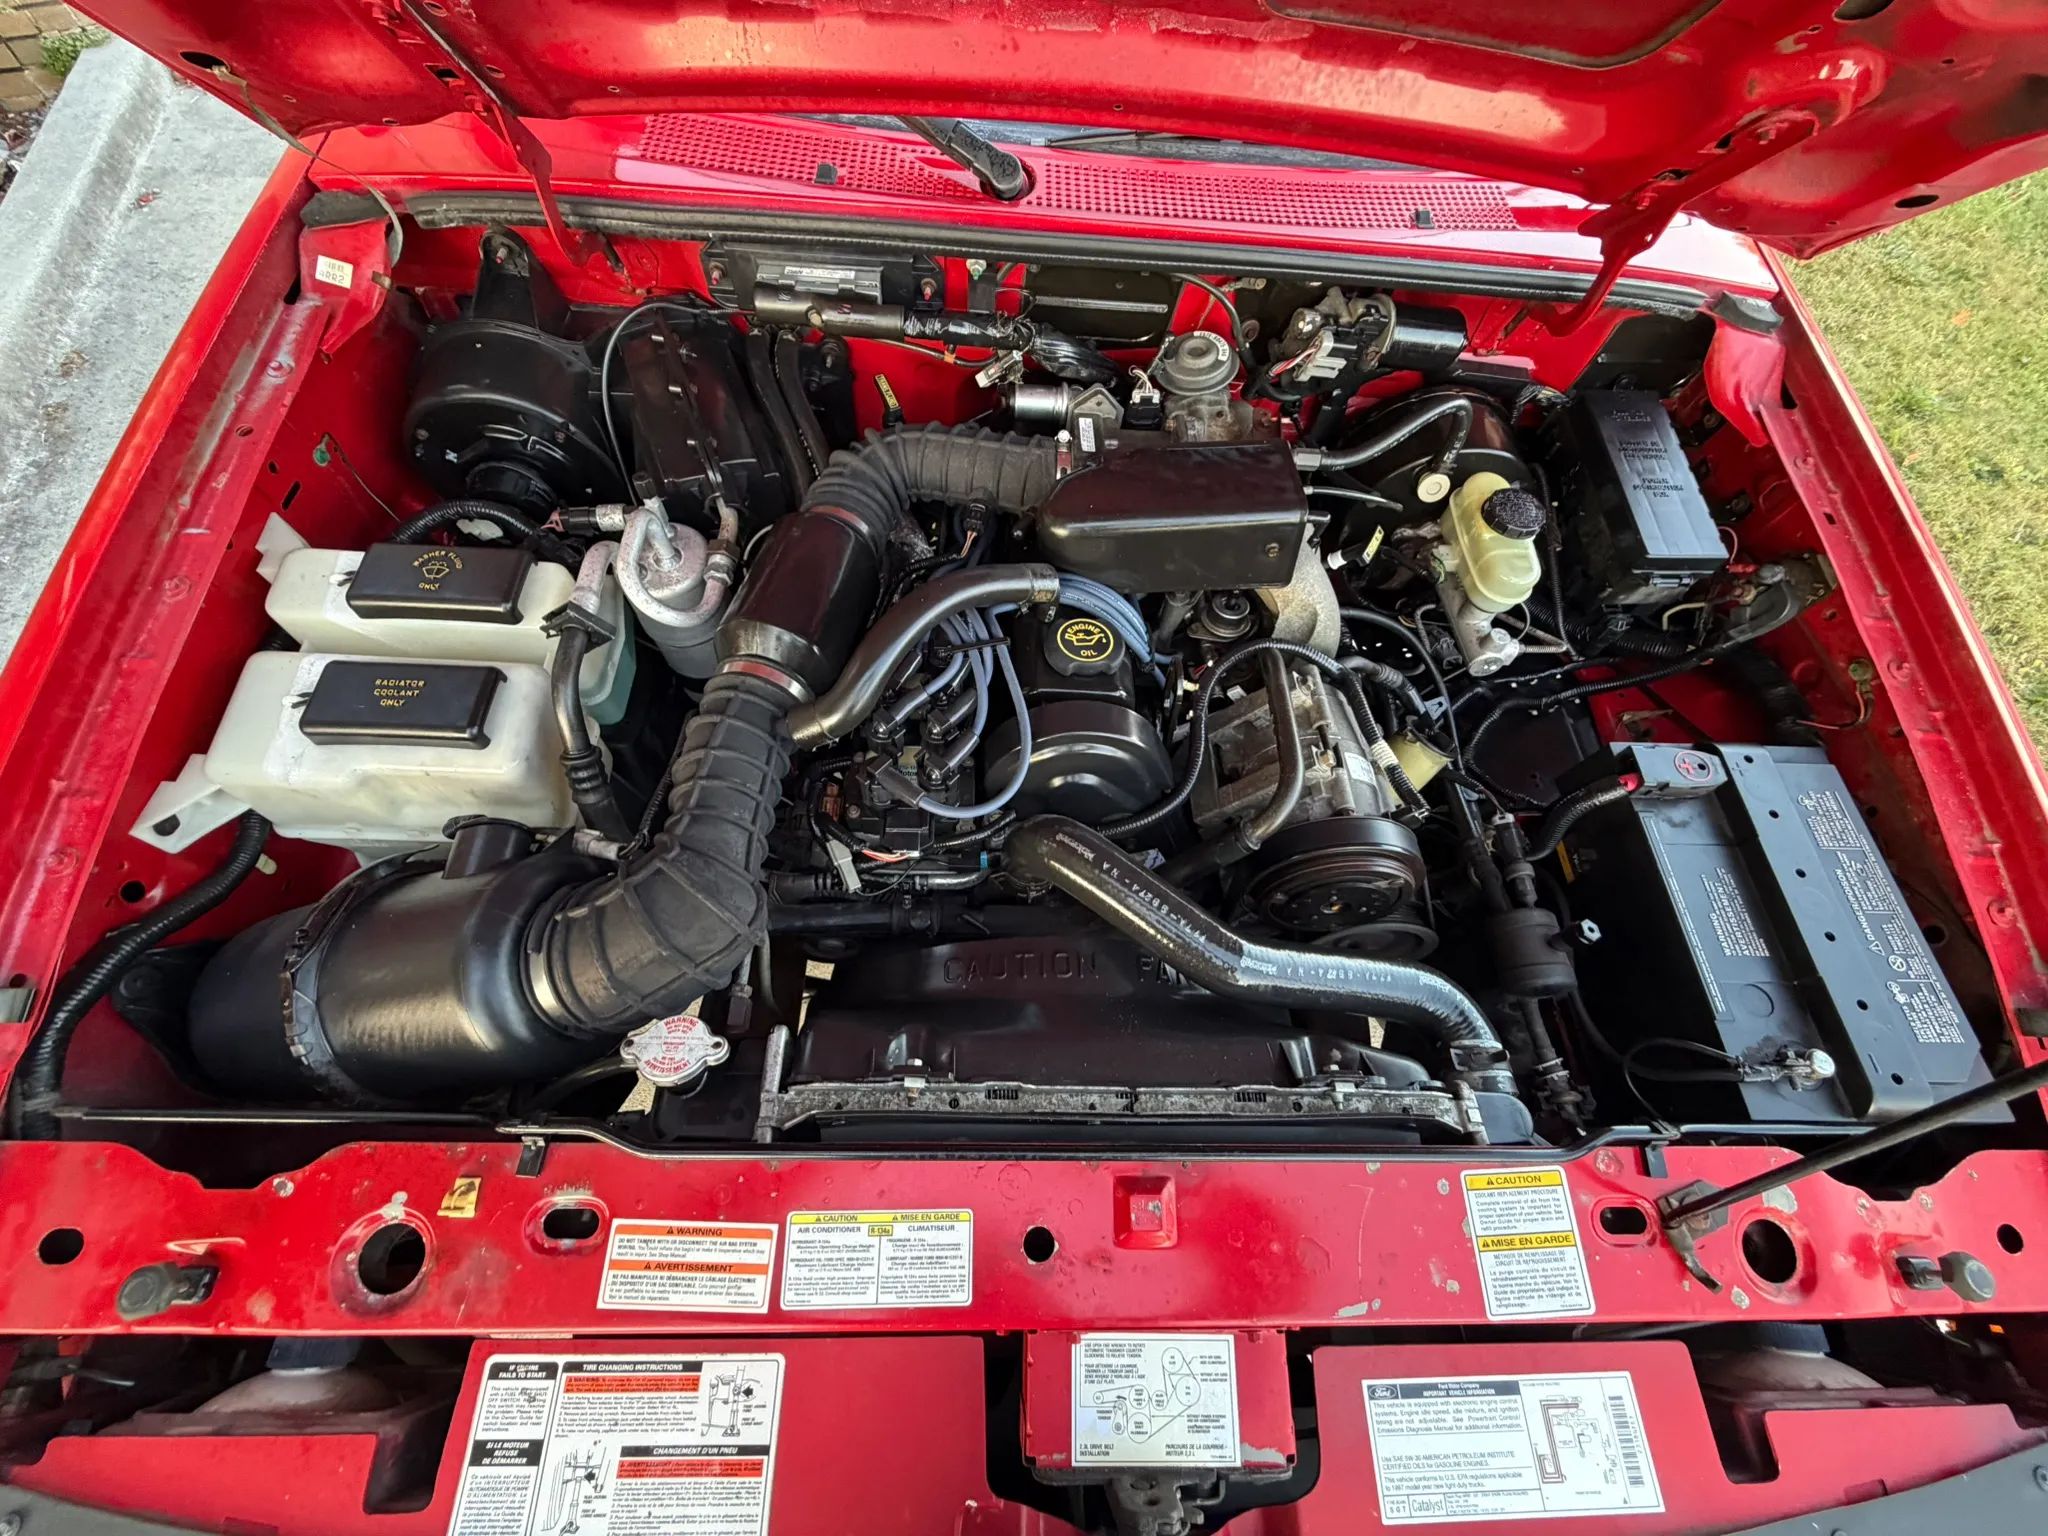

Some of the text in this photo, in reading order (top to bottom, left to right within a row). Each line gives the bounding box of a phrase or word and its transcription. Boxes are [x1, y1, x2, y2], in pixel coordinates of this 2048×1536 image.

[412, 550, 464, 570] WASHER FLUID
[418, 582, 440, 591] ONLY
[1067, 623, 1101, 634] ENGINE
[1080, 649, 1098, 657] OIL
[375, 678, 425, 688] RADIATOR
[374, 688, 419, 697] COOLANT
[380, 698, 406, 708] ONLY
[1833, 868, 1875, 940] DANGER/POISON
[1714, 880, 1750, 957] AVERTISSEMENT
[1711, 912, 1733, 956] WARNING
[943, 951, 1099, 985] CAUTION
[664, 1016, 699, 1027] WARNING
[644, 1059, 691, 1074] AVERTISSEMENT
[1494, 1175, 1541, 1185] CAUTION
[676, 1227, 723, 1236] WARNING
[1490, 1234, 1572, 1247] MISE EN GARDE
[653, 1262, 733, 1272] AVERTISSEMENT
[1372, 1386, 1391, 1397] Ford
[1451, 1398, 1478, 1406] electronic
[1399, 1409, 1419, 1417] Engine
[1420, 1408, 1431, 1416] idle
[1452, 1407, 1463, 1415] idle
[1499, 1405, 1520, 1413] ignition
[1467, 1414, 1497, 1422] Powertrain
[1376, 1426, 1404, 1434] Emissions
[1405, 1425, 1432, 1433] Diagnosis
[1432, 1424, 1454, 1432] Manual
[1463, 1423, 1490, 1431] additional
[1490, 1422, 1523, 1430] information.
[1421, 1453, 1451, 1461] AMERICAN
[1451, 1451, 1486, 1459] PETROLEUM
[1486, 1450, 1515, 1458] INSTITUTE
[1381, 1462, 1412, 1470] CERTIFIED
[1433, 1460, 1462, 1468] GASOLINE
[1456, 1473, 1468, 1481] EPA
[1468, 1472, 1496, 1480] regulations
[1496, 1471, 1523, 1479] applicable
[1404, 1483, 1421, 1491] model
[1433, 1482, 1444, 1490] new
[1410, 1498, 1444, 1514] Catalyst
